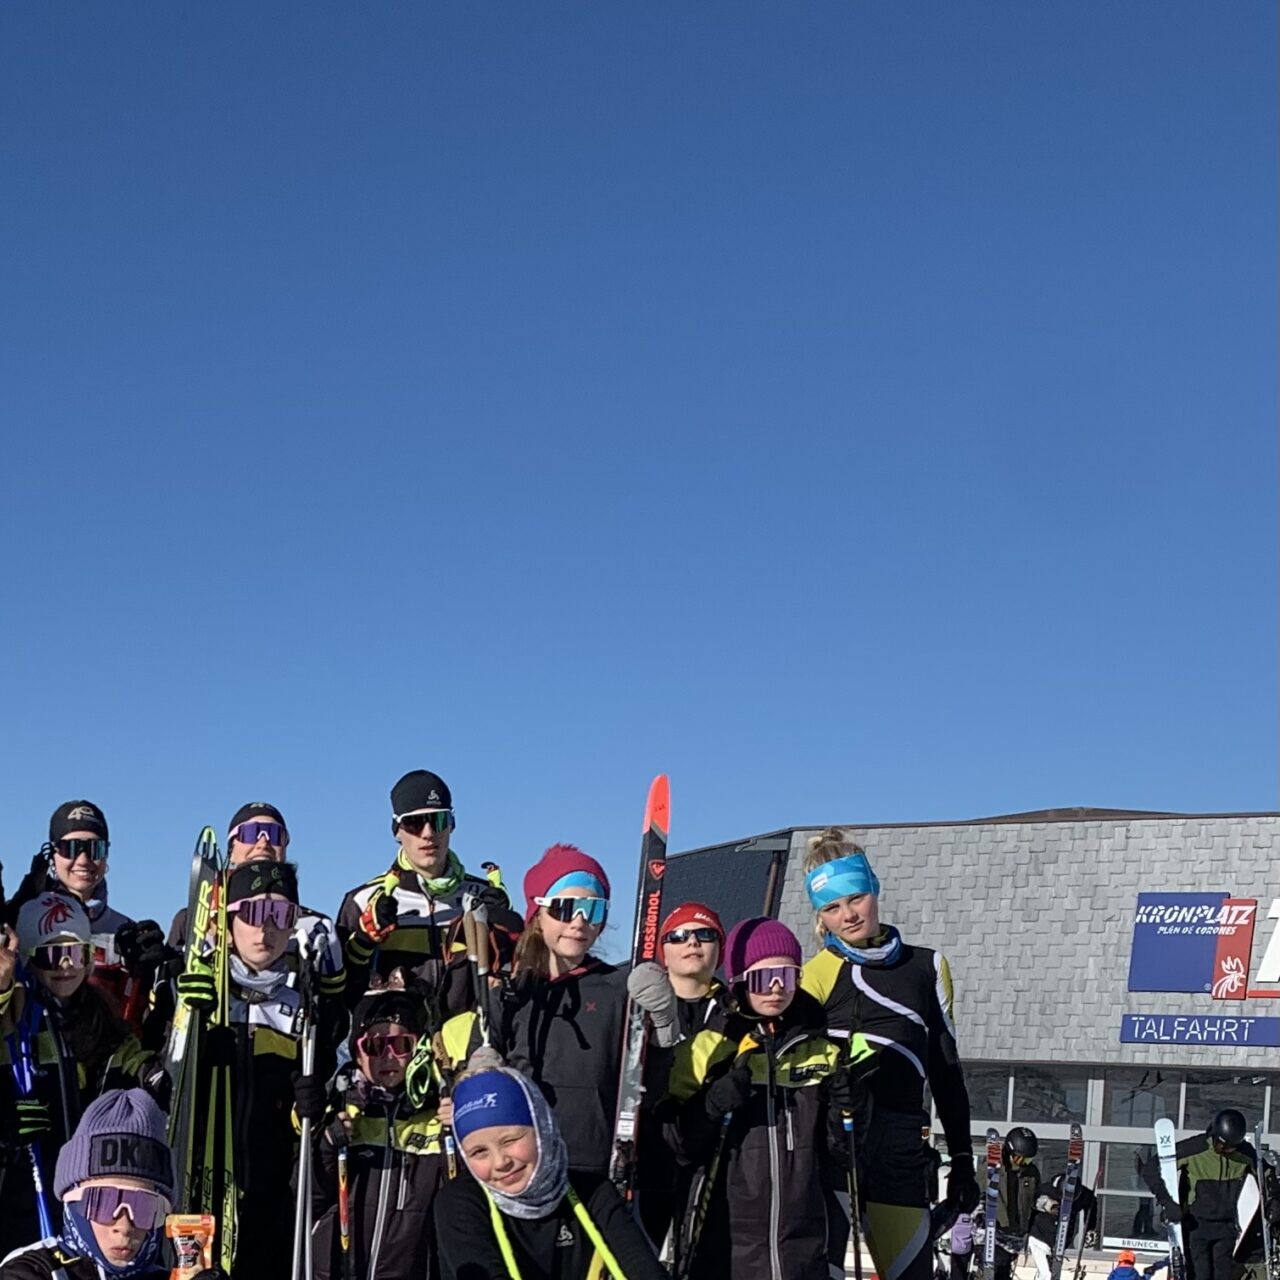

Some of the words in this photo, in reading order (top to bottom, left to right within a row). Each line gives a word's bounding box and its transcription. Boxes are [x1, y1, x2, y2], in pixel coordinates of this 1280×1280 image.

[642, 889, 661, 959] ROSSIGNOL
[1135, 905, 1256, 924] KRONPLATZ
[187, 879, 213, 974] CHER
[1195, 926, 1237, 935] CORONES
[1131, 1016, 1256, 1041] TALFAHRT
[1121, 1239, 1160, 1249] BRUNECK
